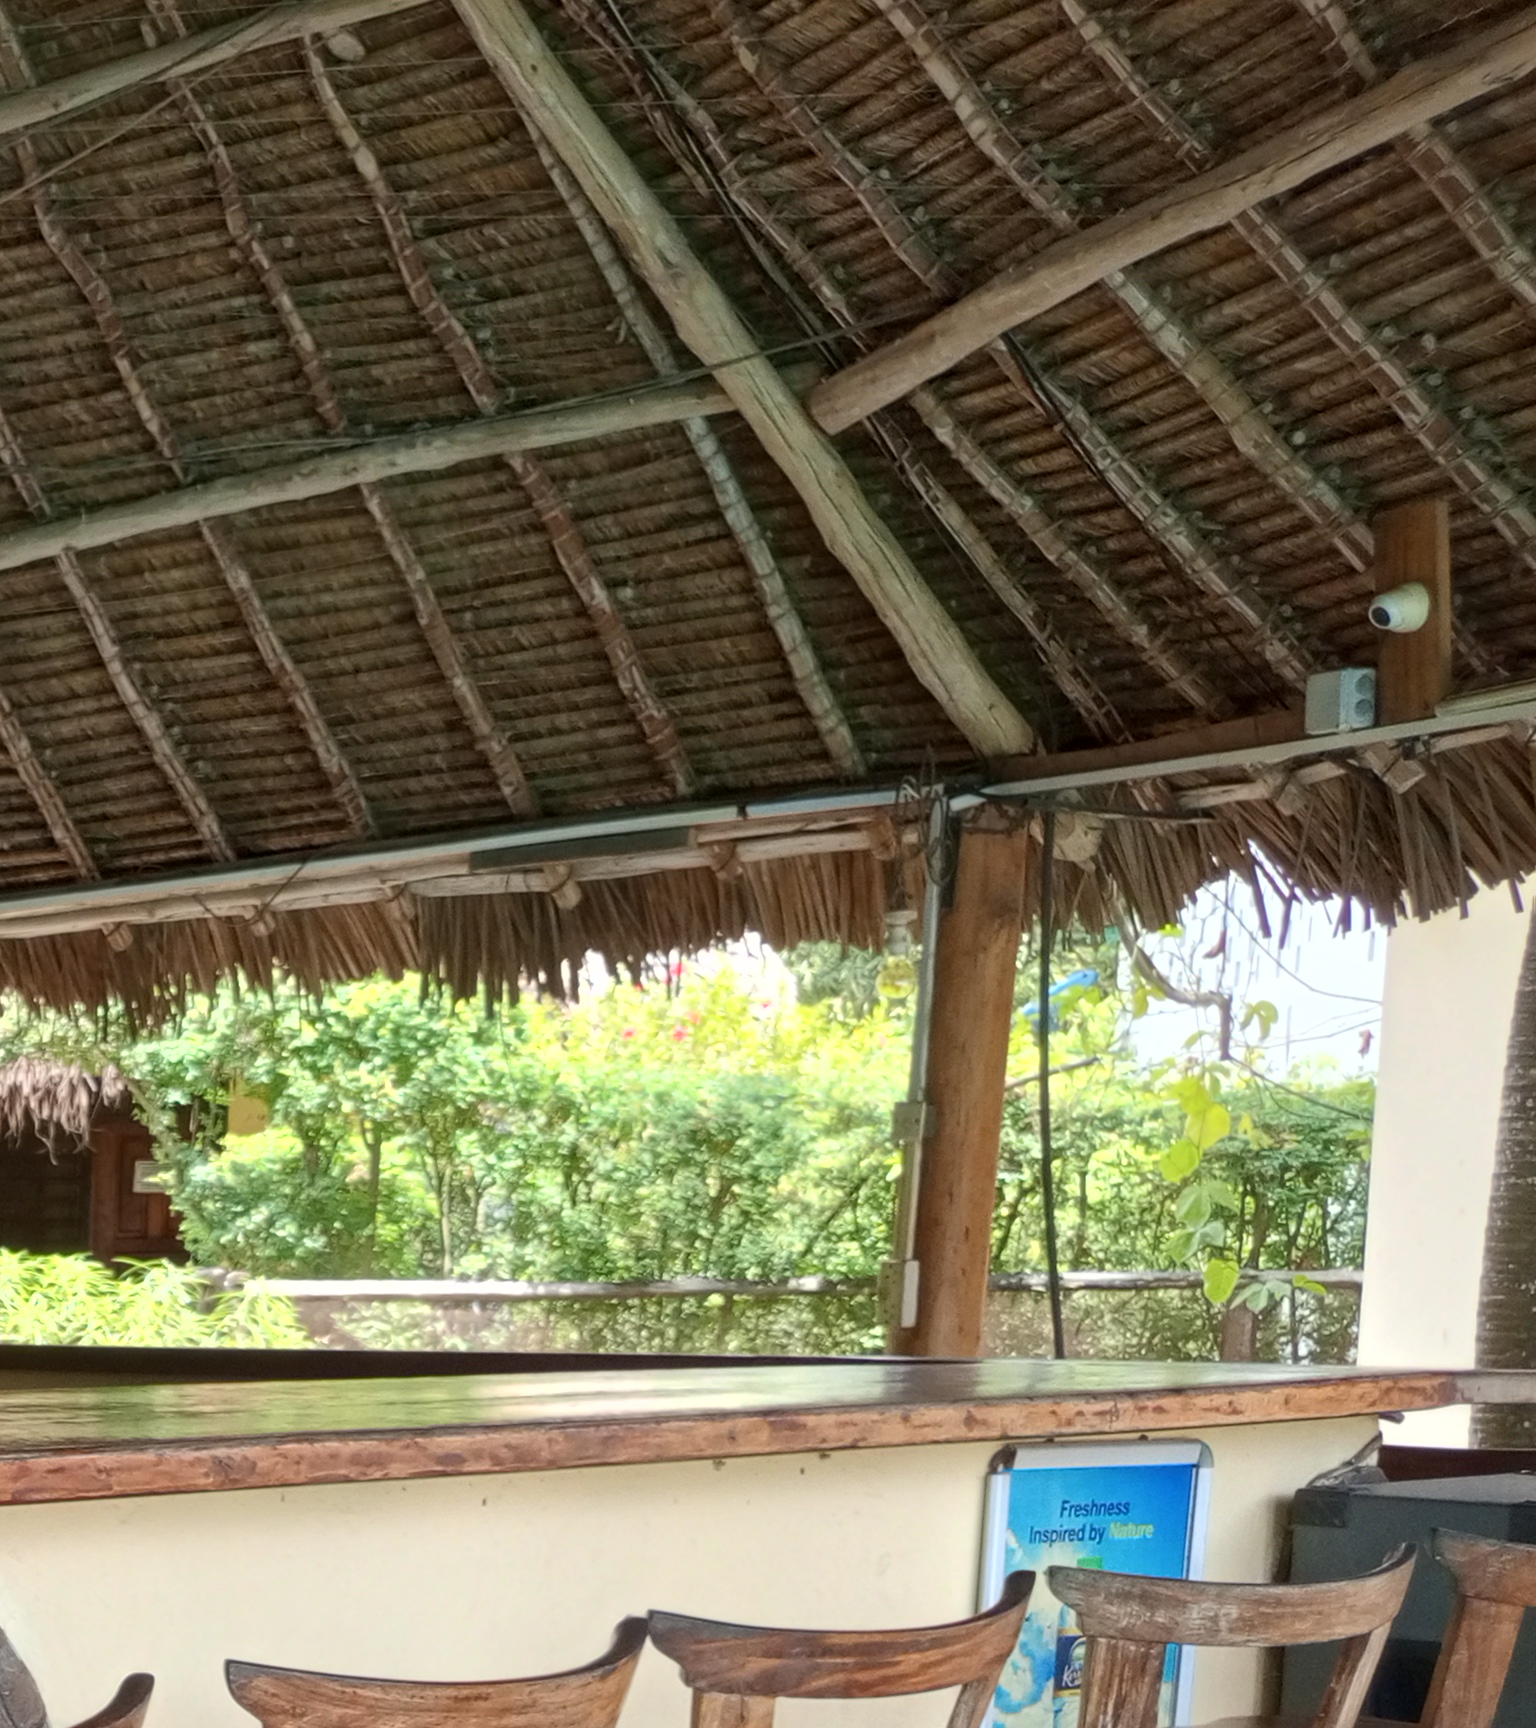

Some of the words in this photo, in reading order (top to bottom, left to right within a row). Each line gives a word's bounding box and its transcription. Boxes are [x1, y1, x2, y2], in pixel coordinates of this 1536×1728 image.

[1059, 1499, 1131, 1518] Freshness
[1029, 1523, 1085, 1548] Inspired
[1088, 1523, 1107, 1545] by
[1109, 1521, 1155, 1540] Nature
